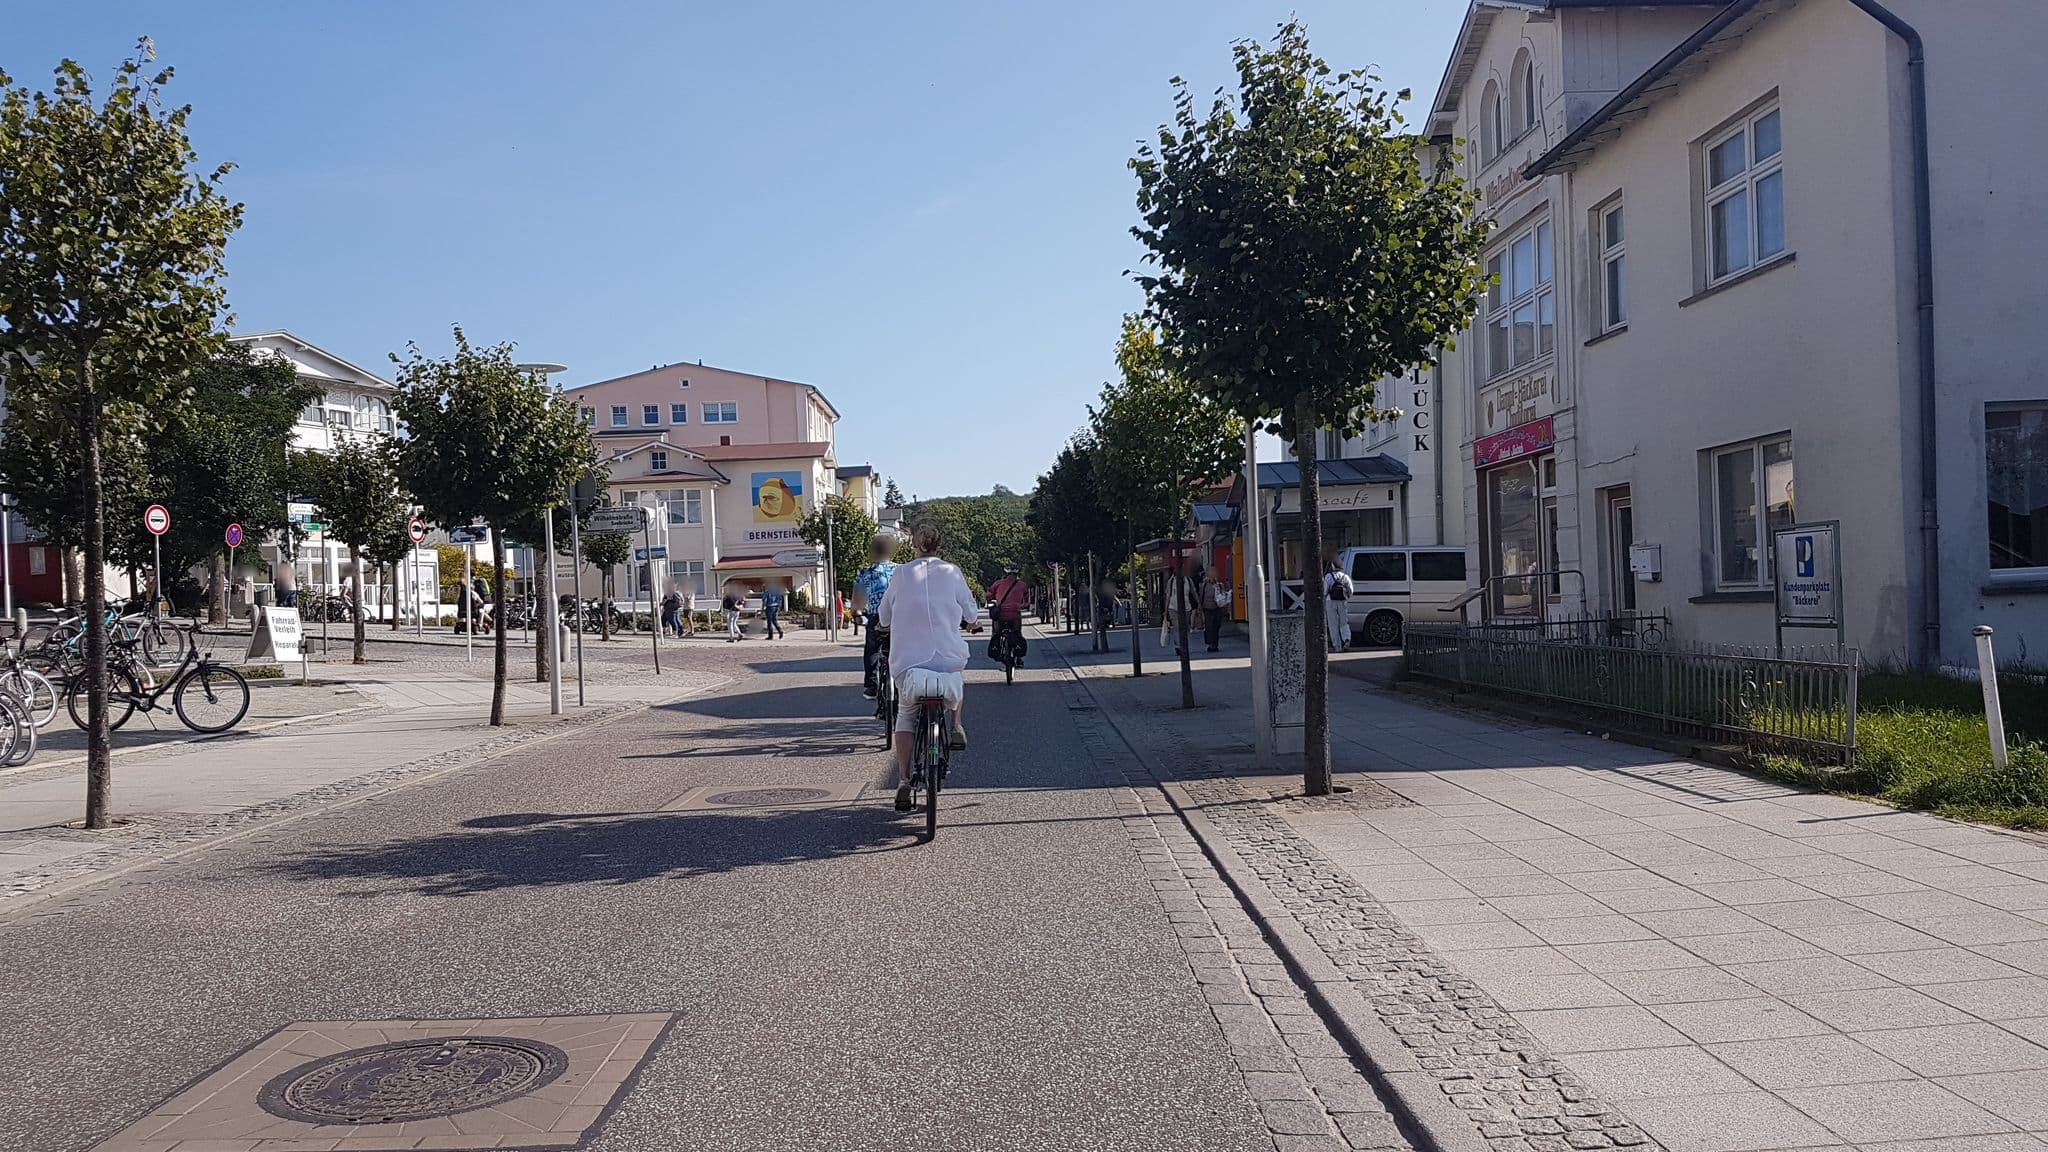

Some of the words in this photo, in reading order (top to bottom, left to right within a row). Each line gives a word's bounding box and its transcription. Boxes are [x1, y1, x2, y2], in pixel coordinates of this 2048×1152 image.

[1319, 488, 1369, 507] scafé
[749, 530, 798, 540] BERNSTEIN
[1783, 582, 1830, 594] Kundenparkplatz
[271, 616, 298, 625] Fahrrad-
[274, 625, 296, 633] Verleih
